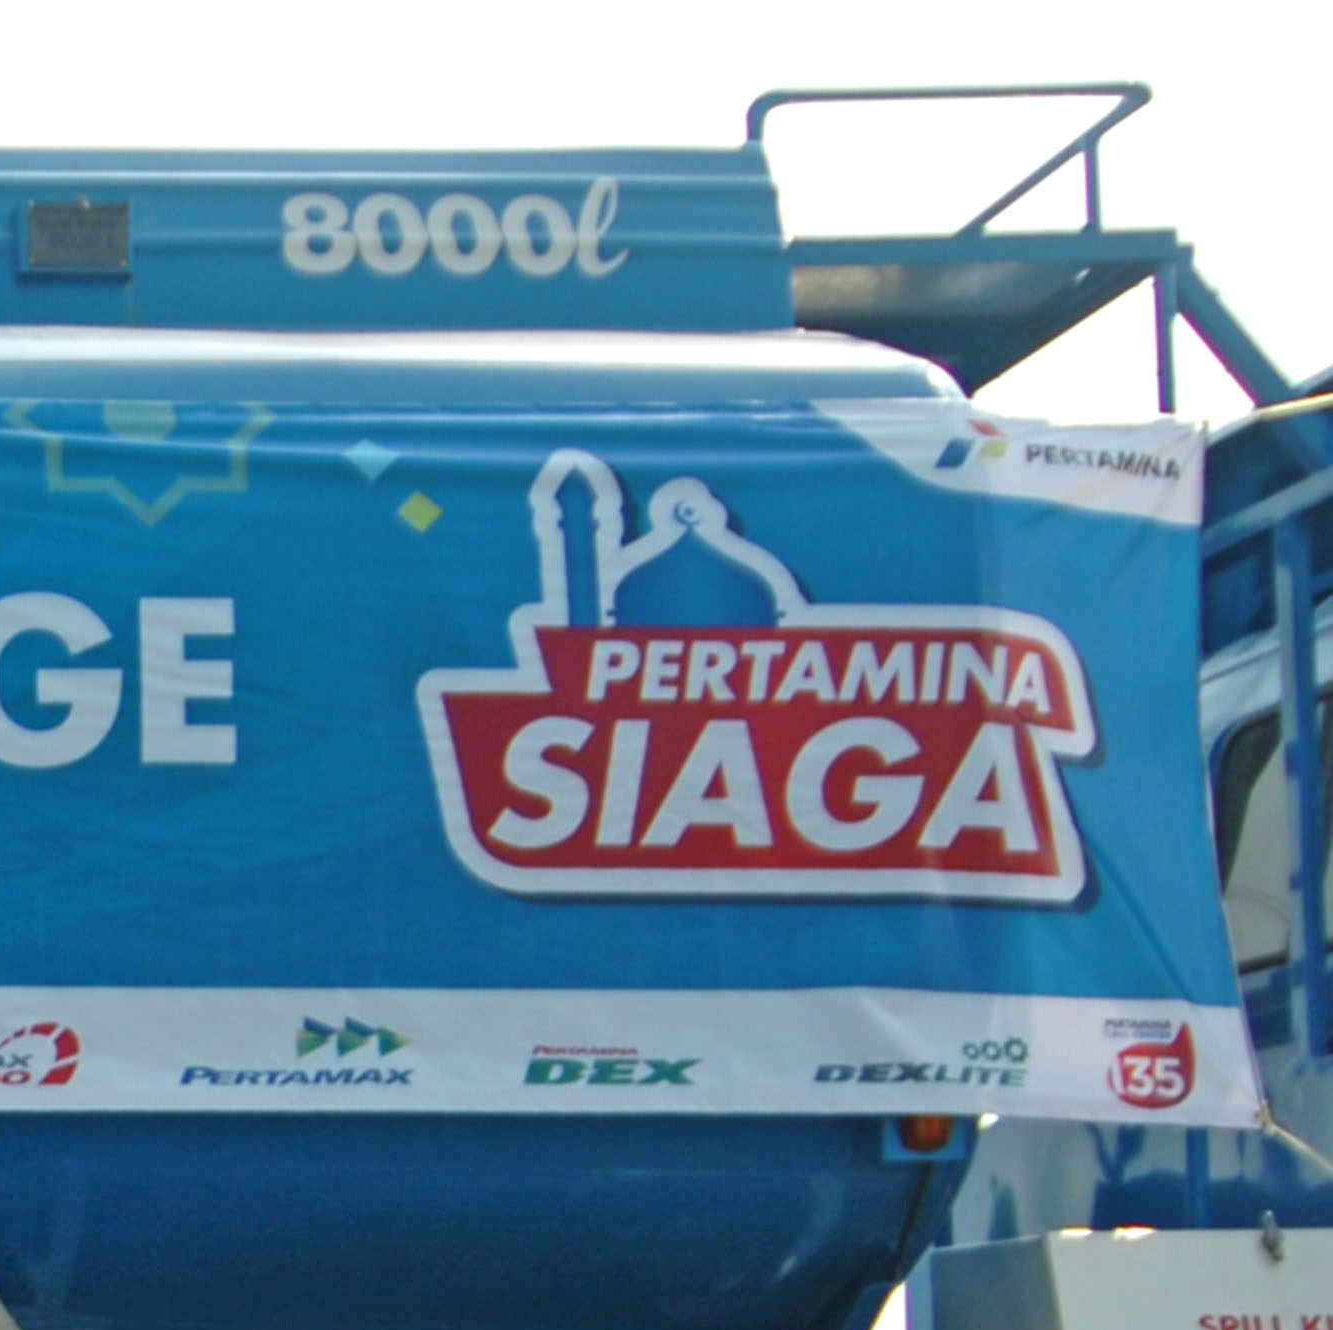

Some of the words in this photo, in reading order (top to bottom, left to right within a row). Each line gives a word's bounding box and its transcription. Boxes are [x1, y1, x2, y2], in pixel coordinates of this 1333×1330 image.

[1025, 443, 1181, 480] PERTAMINA
[585, 639, 1052, 715] PERTAMINA
[488, 716, 1040, 853] SIAGA
[179, 1065, 415, 1086] PERTAMAX
[523, 1058, 704, 1086] DEX
[812, 1062, 1029, 1087] DEXLITE
